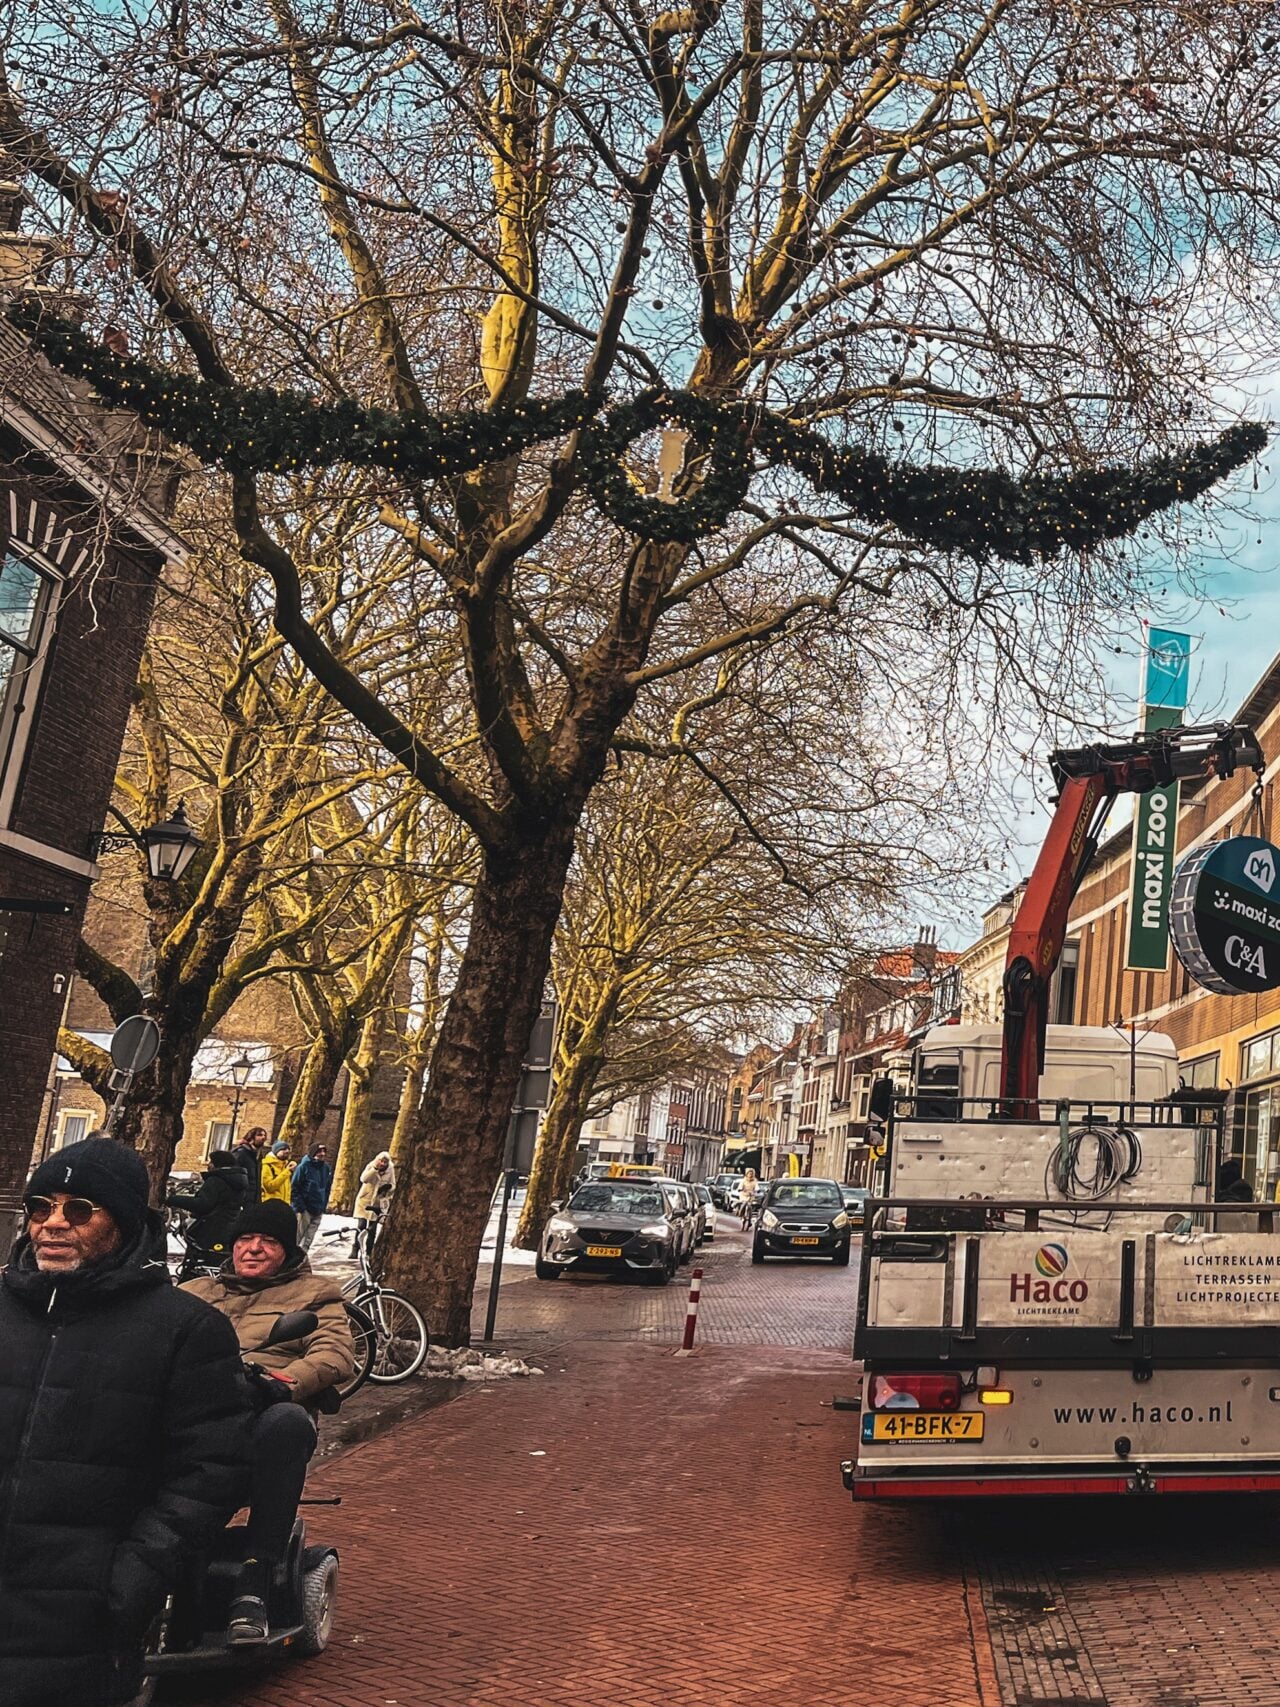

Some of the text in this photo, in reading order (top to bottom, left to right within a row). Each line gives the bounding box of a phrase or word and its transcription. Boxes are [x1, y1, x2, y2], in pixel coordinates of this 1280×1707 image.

[1138, 793, 1168, 929] maxi zoo
[1232, 899, 1267, 924] maxi
[1224, 935, 1268, 980] C&A
[1010, 1273, 1089, 1303] Haco
[1195, 1274, 1272, 1285] TERRASSEN
[1018, 1307, 1080, 1315] LICHTREKLAME
[1053, 1401, 1233, 1424] www.haco.nl
[884, 1416, 973, 1435] 41-BFK-7
